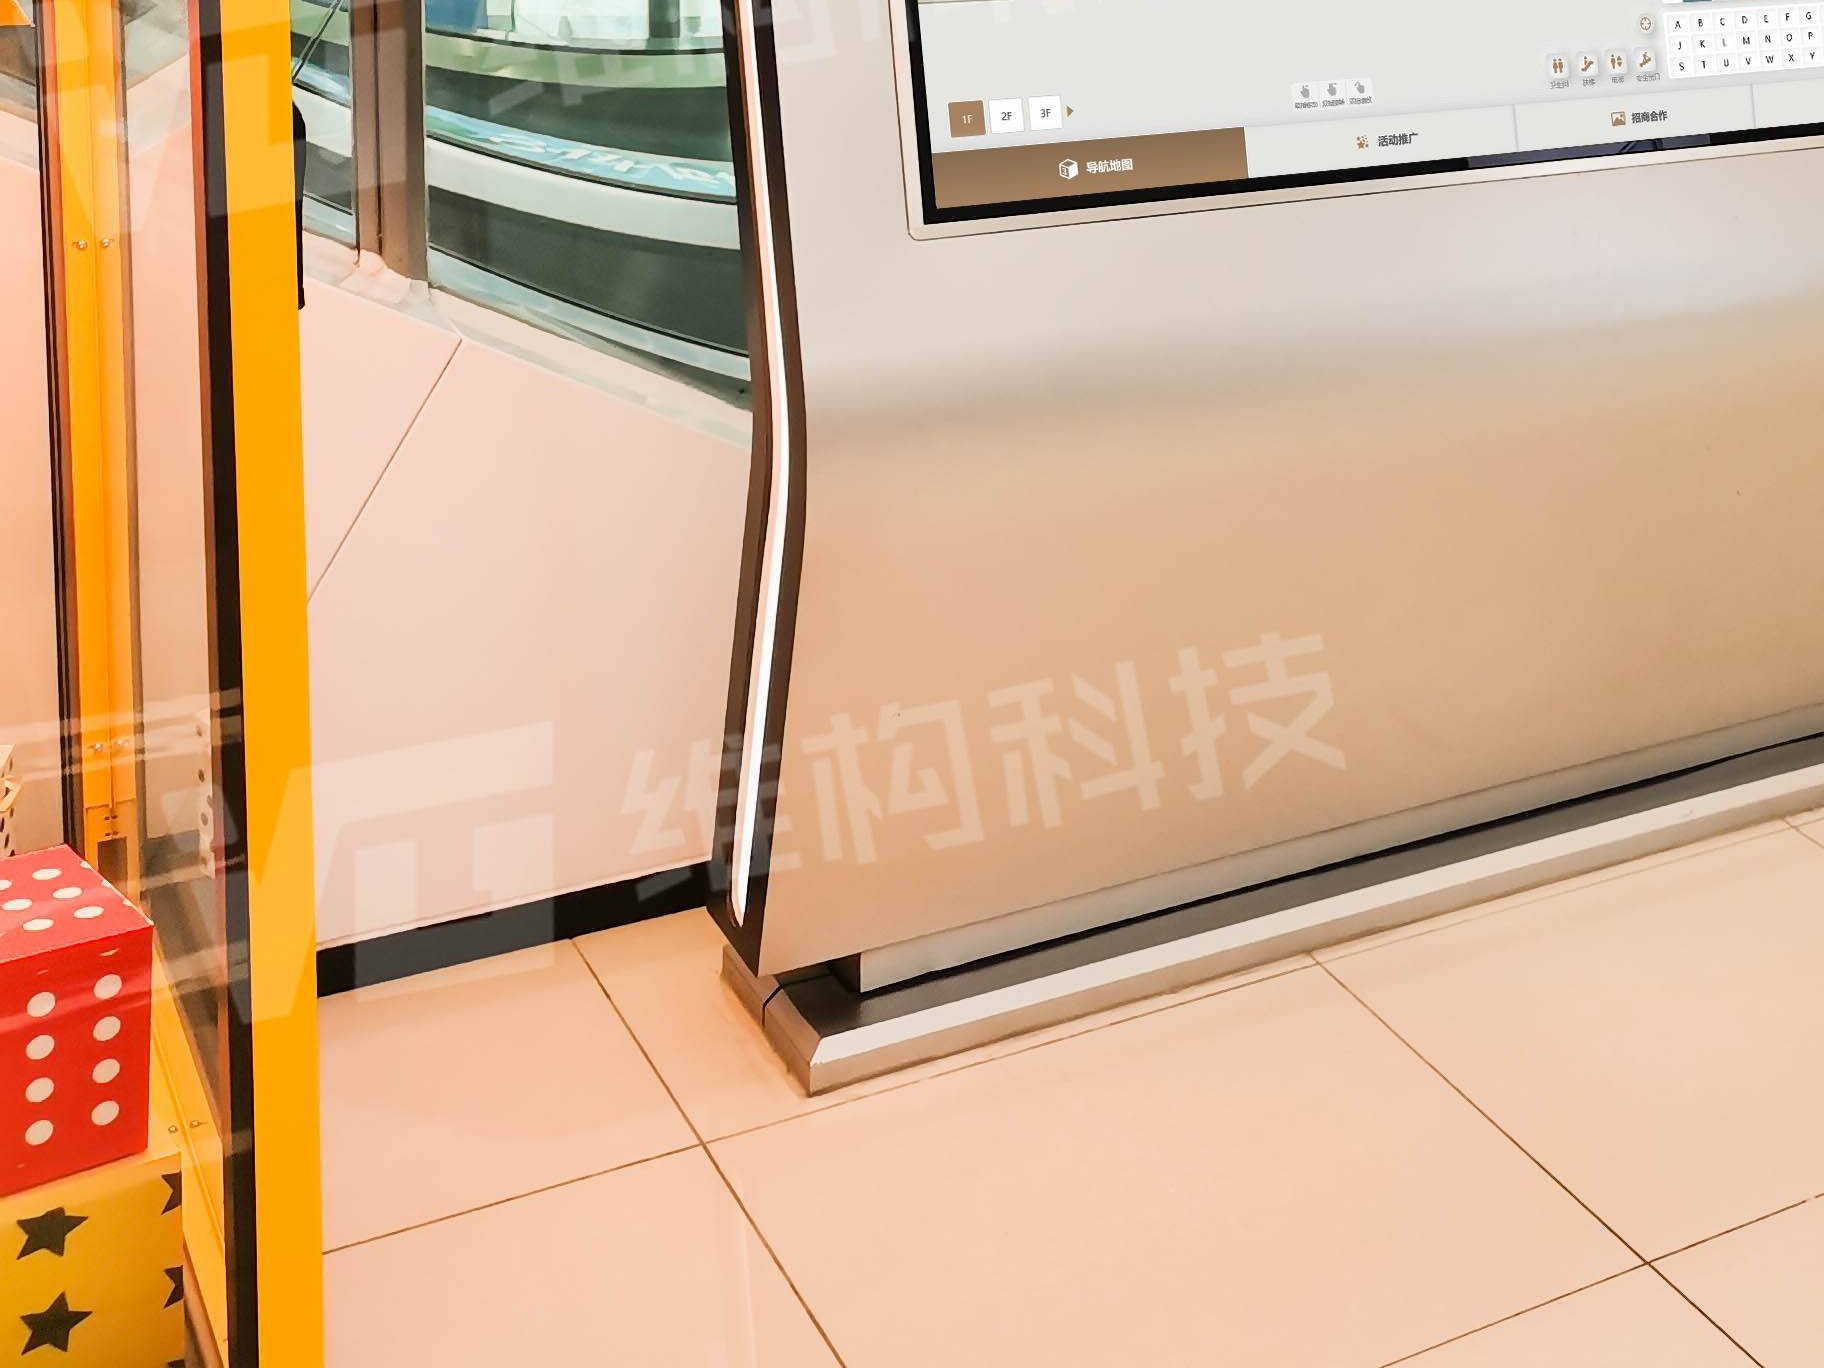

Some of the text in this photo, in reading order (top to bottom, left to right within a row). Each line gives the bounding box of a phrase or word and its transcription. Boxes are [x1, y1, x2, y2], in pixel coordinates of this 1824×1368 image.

[962, 108, 1051, 124] 1F 2F 3F
[1632, 110, 1668, 124] 招商合作
[1378, 133, 1418, 147] 活动推广
[1085, 158, 1133, 174] 导航地图
